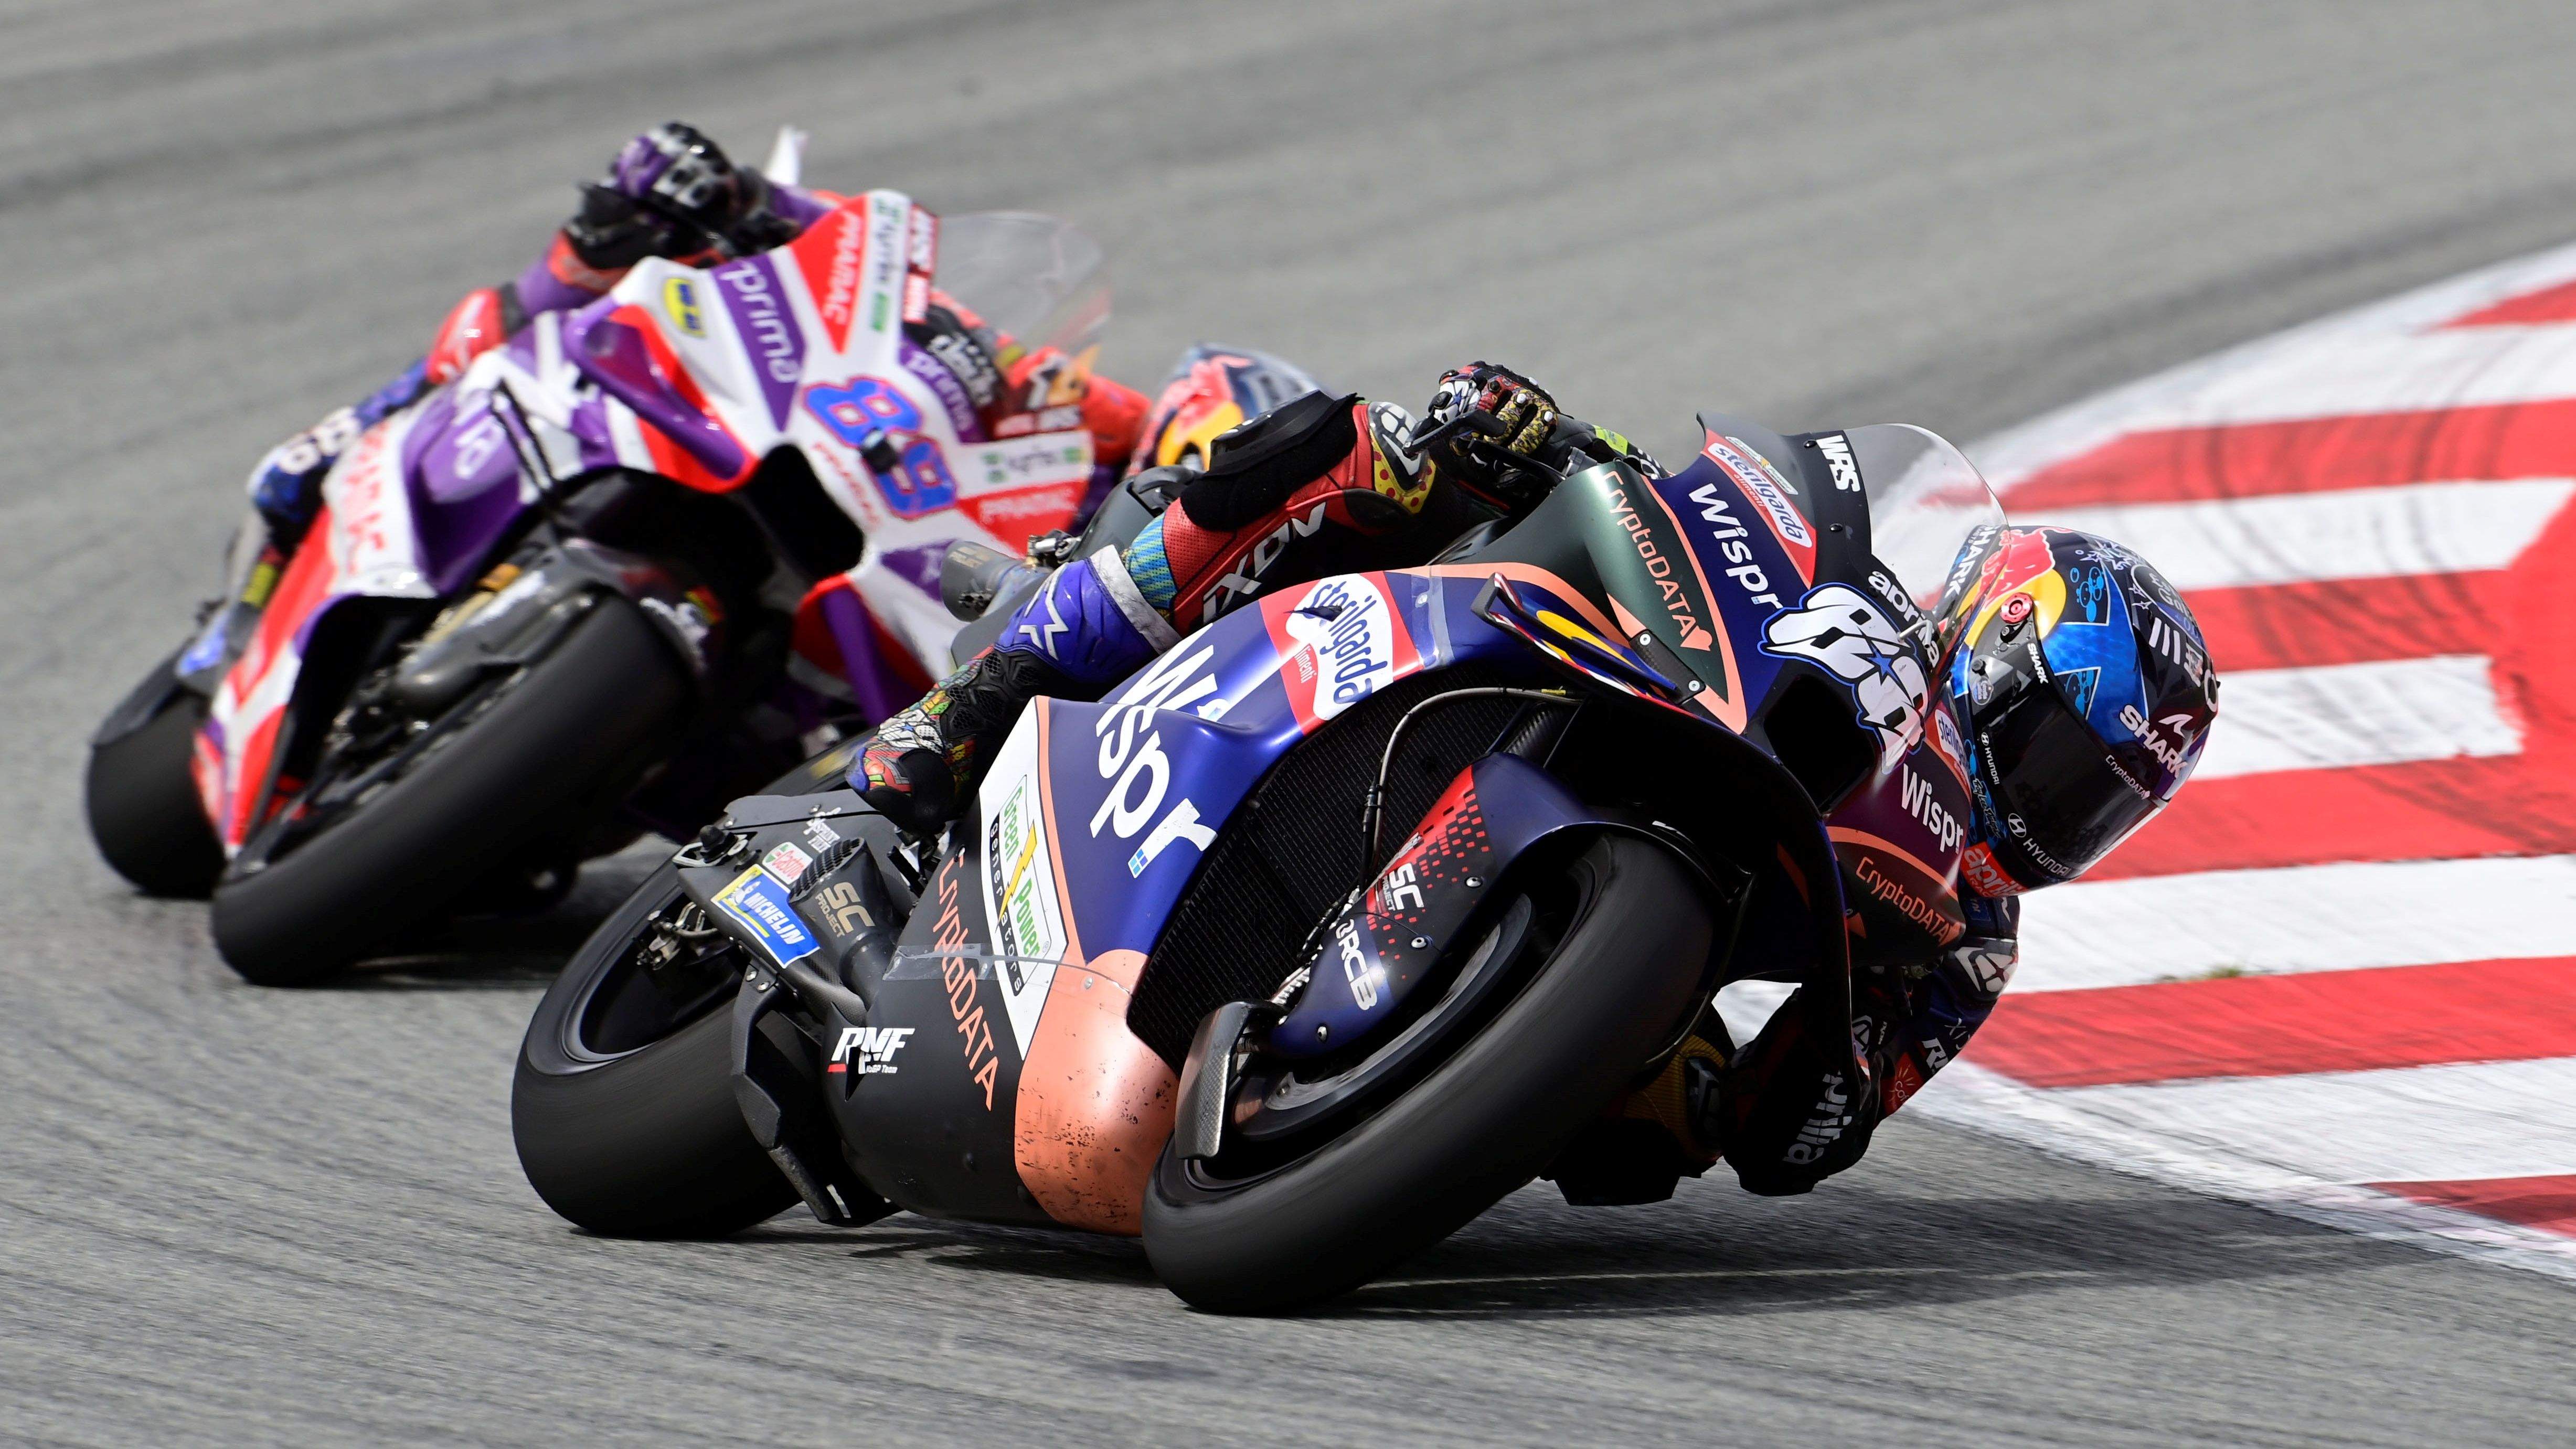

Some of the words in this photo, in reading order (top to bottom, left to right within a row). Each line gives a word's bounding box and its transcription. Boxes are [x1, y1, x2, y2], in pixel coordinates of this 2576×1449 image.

[719, 260, 804, 384] prima
[1716, 448, 1804, 539] sterilgarda
[1815, 434, 1861, 493] WRS
[1603, 470, 1699, 638] CryptoDATA
[1688, 483, 1784, 609] Wispr
[2027, 643, 2049, 684] SHARK
[1090, 623, 1230, 879] Wispr
[1984, 747, 2000, 785] HYUNDAI
[2105, 754, 2147, 799] CryptoDATA
[2120, 704, 2188, 779] SHARK
[1004, 786, 1023, 862] Green
[1901, 763, 1964, 855] Wispr
[1388, 862, 1424, 911] SC
[1964, 848, 2023, 896] aprili
[2023, 838, 2072, 877] HYUNDAI
[743, 892, 806, 945] MICHELIN
[815, 893, 846, 938] PROJECT
[823, 881, 876, 934] SC
[990, 823, 1022, 992] generators
[1013, 878, 1040, 958] Power
[1856, 856, 1950, 943] CryptoDATA
[933, 855, 998, 1111] CryptoDATA
[1338, 929, 1378, 1011] RCB
[831, 1026, 916, 1064] RNF
[1782, 1069, 1853, 1165] prilia
